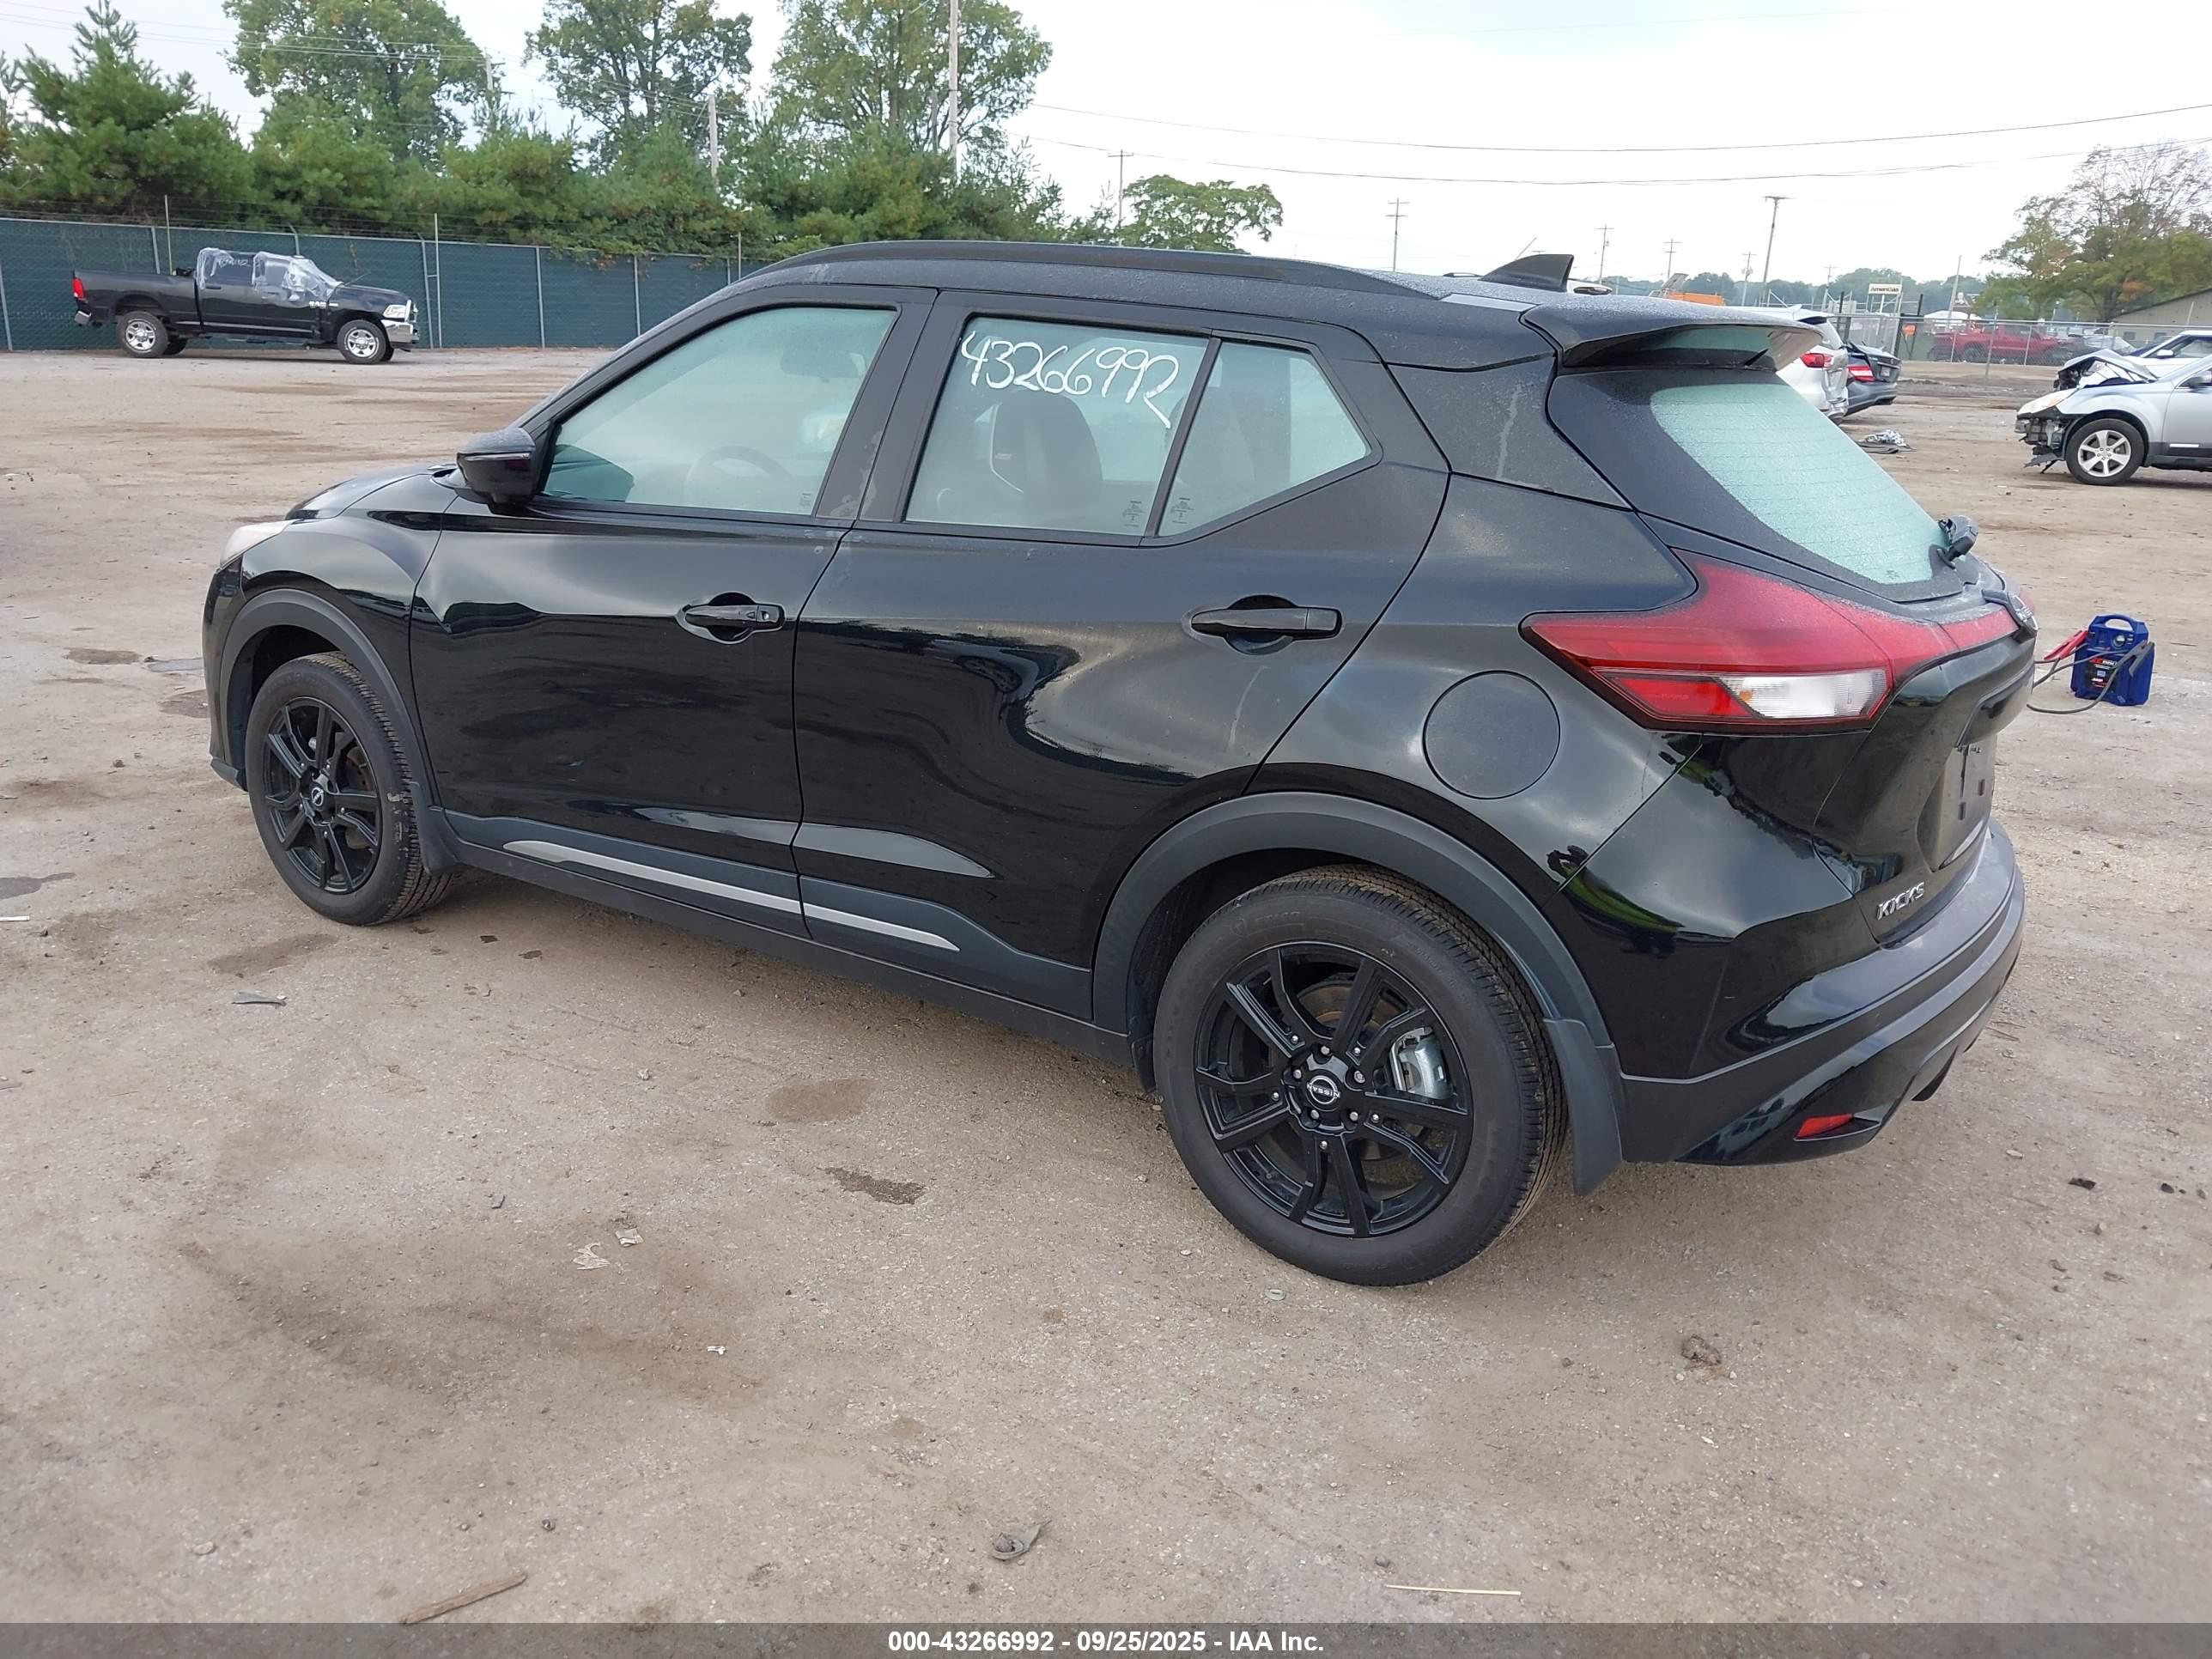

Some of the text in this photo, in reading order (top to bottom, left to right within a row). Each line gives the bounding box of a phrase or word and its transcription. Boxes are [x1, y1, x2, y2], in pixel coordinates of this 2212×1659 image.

[960, 330, 1180, 428] 43266992
[1876, 881, 1924, 921] KICKS
[1306, 1082, 1340, 1099] NISSAN
